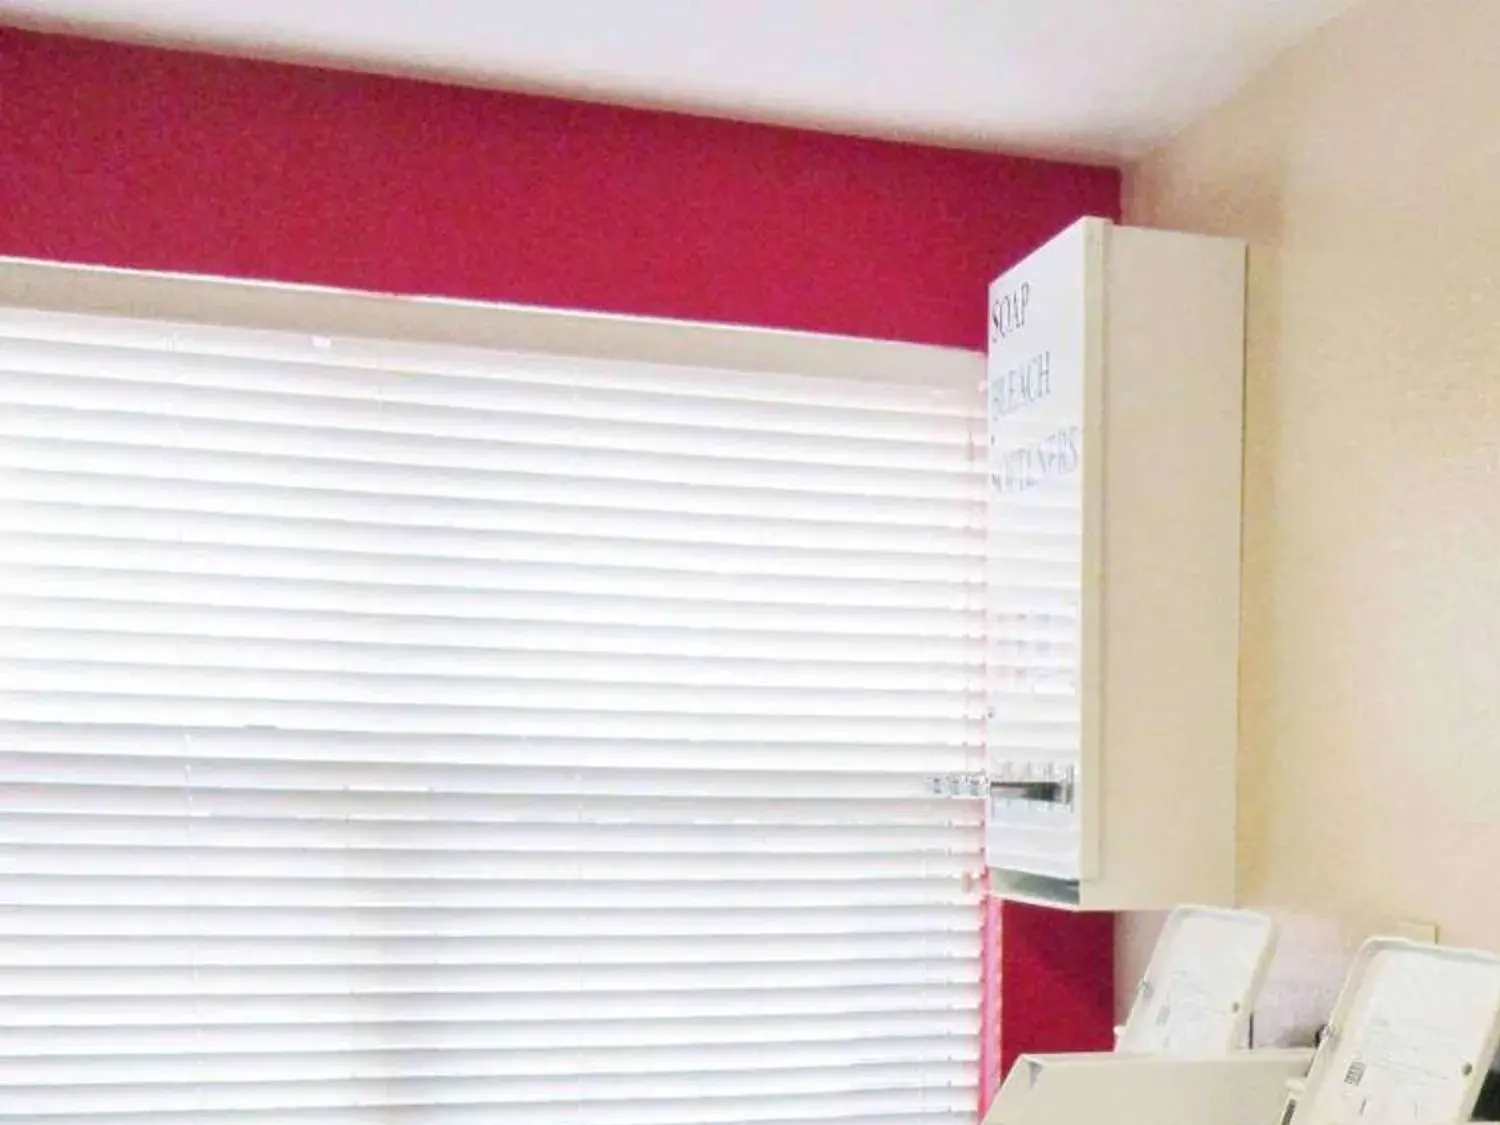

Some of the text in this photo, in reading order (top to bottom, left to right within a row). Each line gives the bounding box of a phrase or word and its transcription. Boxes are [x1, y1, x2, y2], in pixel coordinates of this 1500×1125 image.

[991, 280, 1030, 343] SOAP
[991, 350, 1051, 421] BLEACH
[991, 425, 1079, 493] FTENERS
